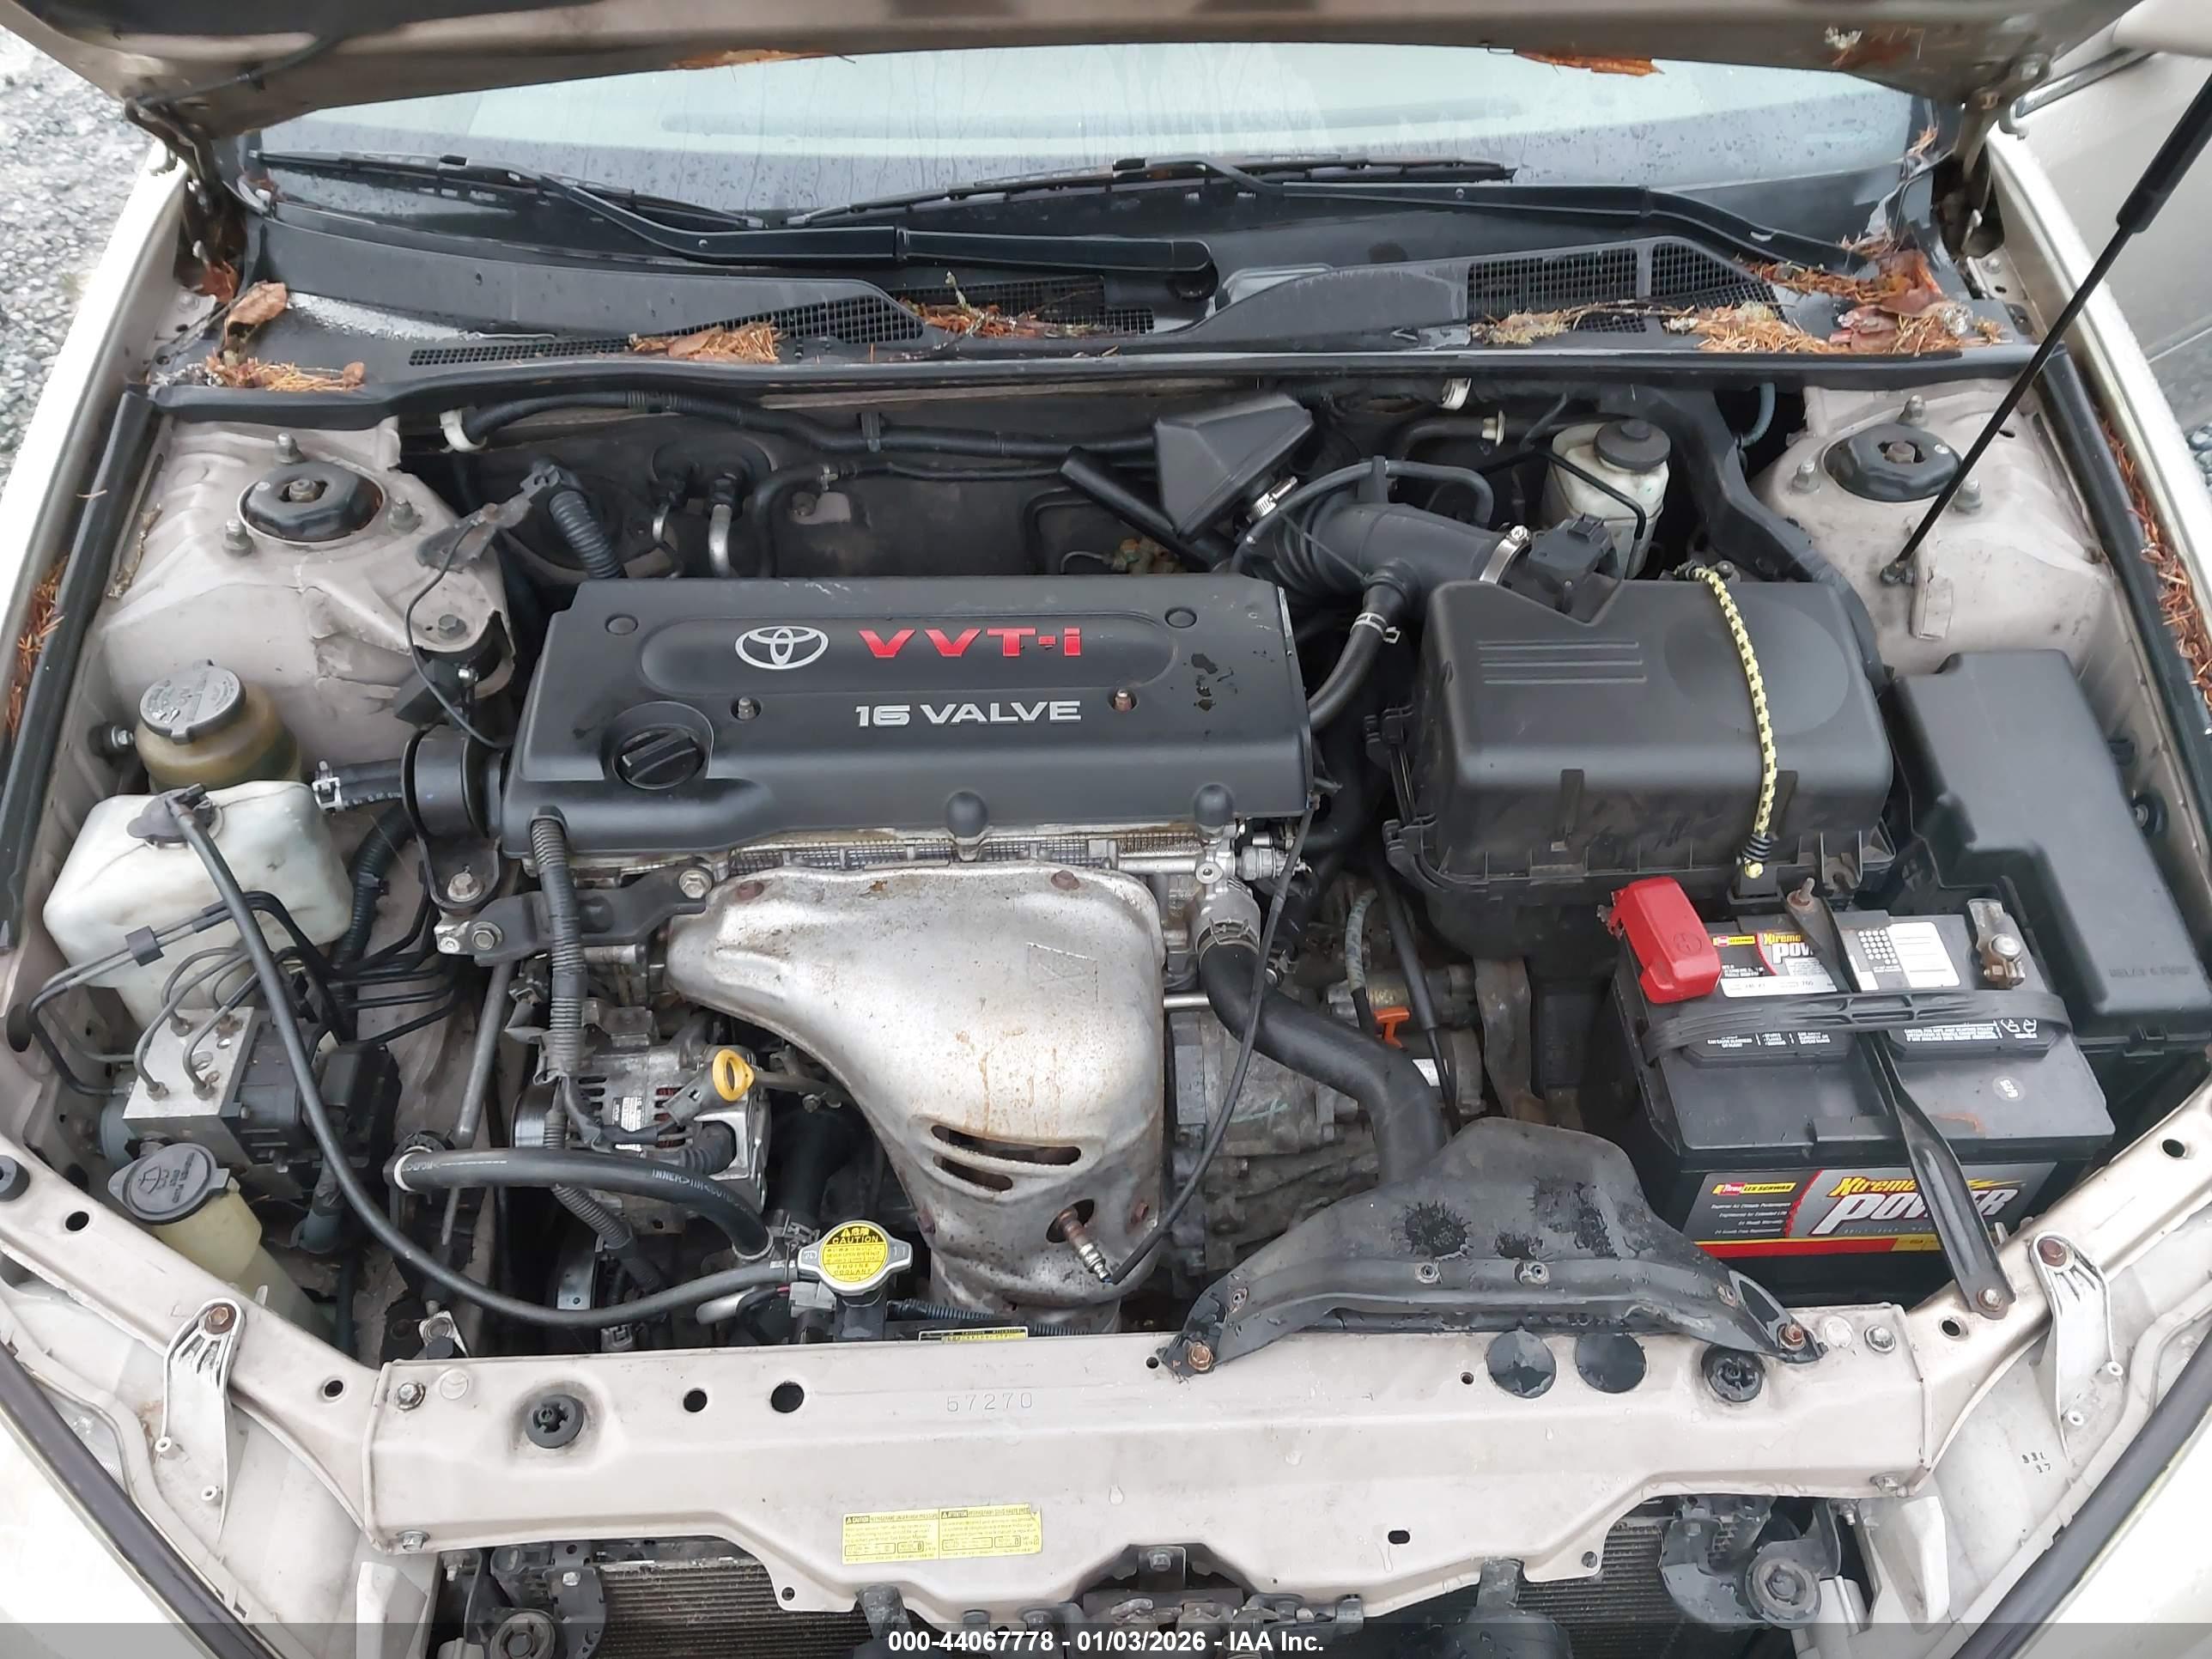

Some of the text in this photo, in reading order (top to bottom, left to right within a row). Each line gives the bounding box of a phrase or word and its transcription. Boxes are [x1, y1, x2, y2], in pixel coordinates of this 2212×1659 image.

[859, 628, 1081, 658] VVT-i
[855, 701, 1082, 727] 16 VALVE
[1827, 1177, 1917, 1197] Xtreme
[832, 1235, 878, 1244] CAUTION
